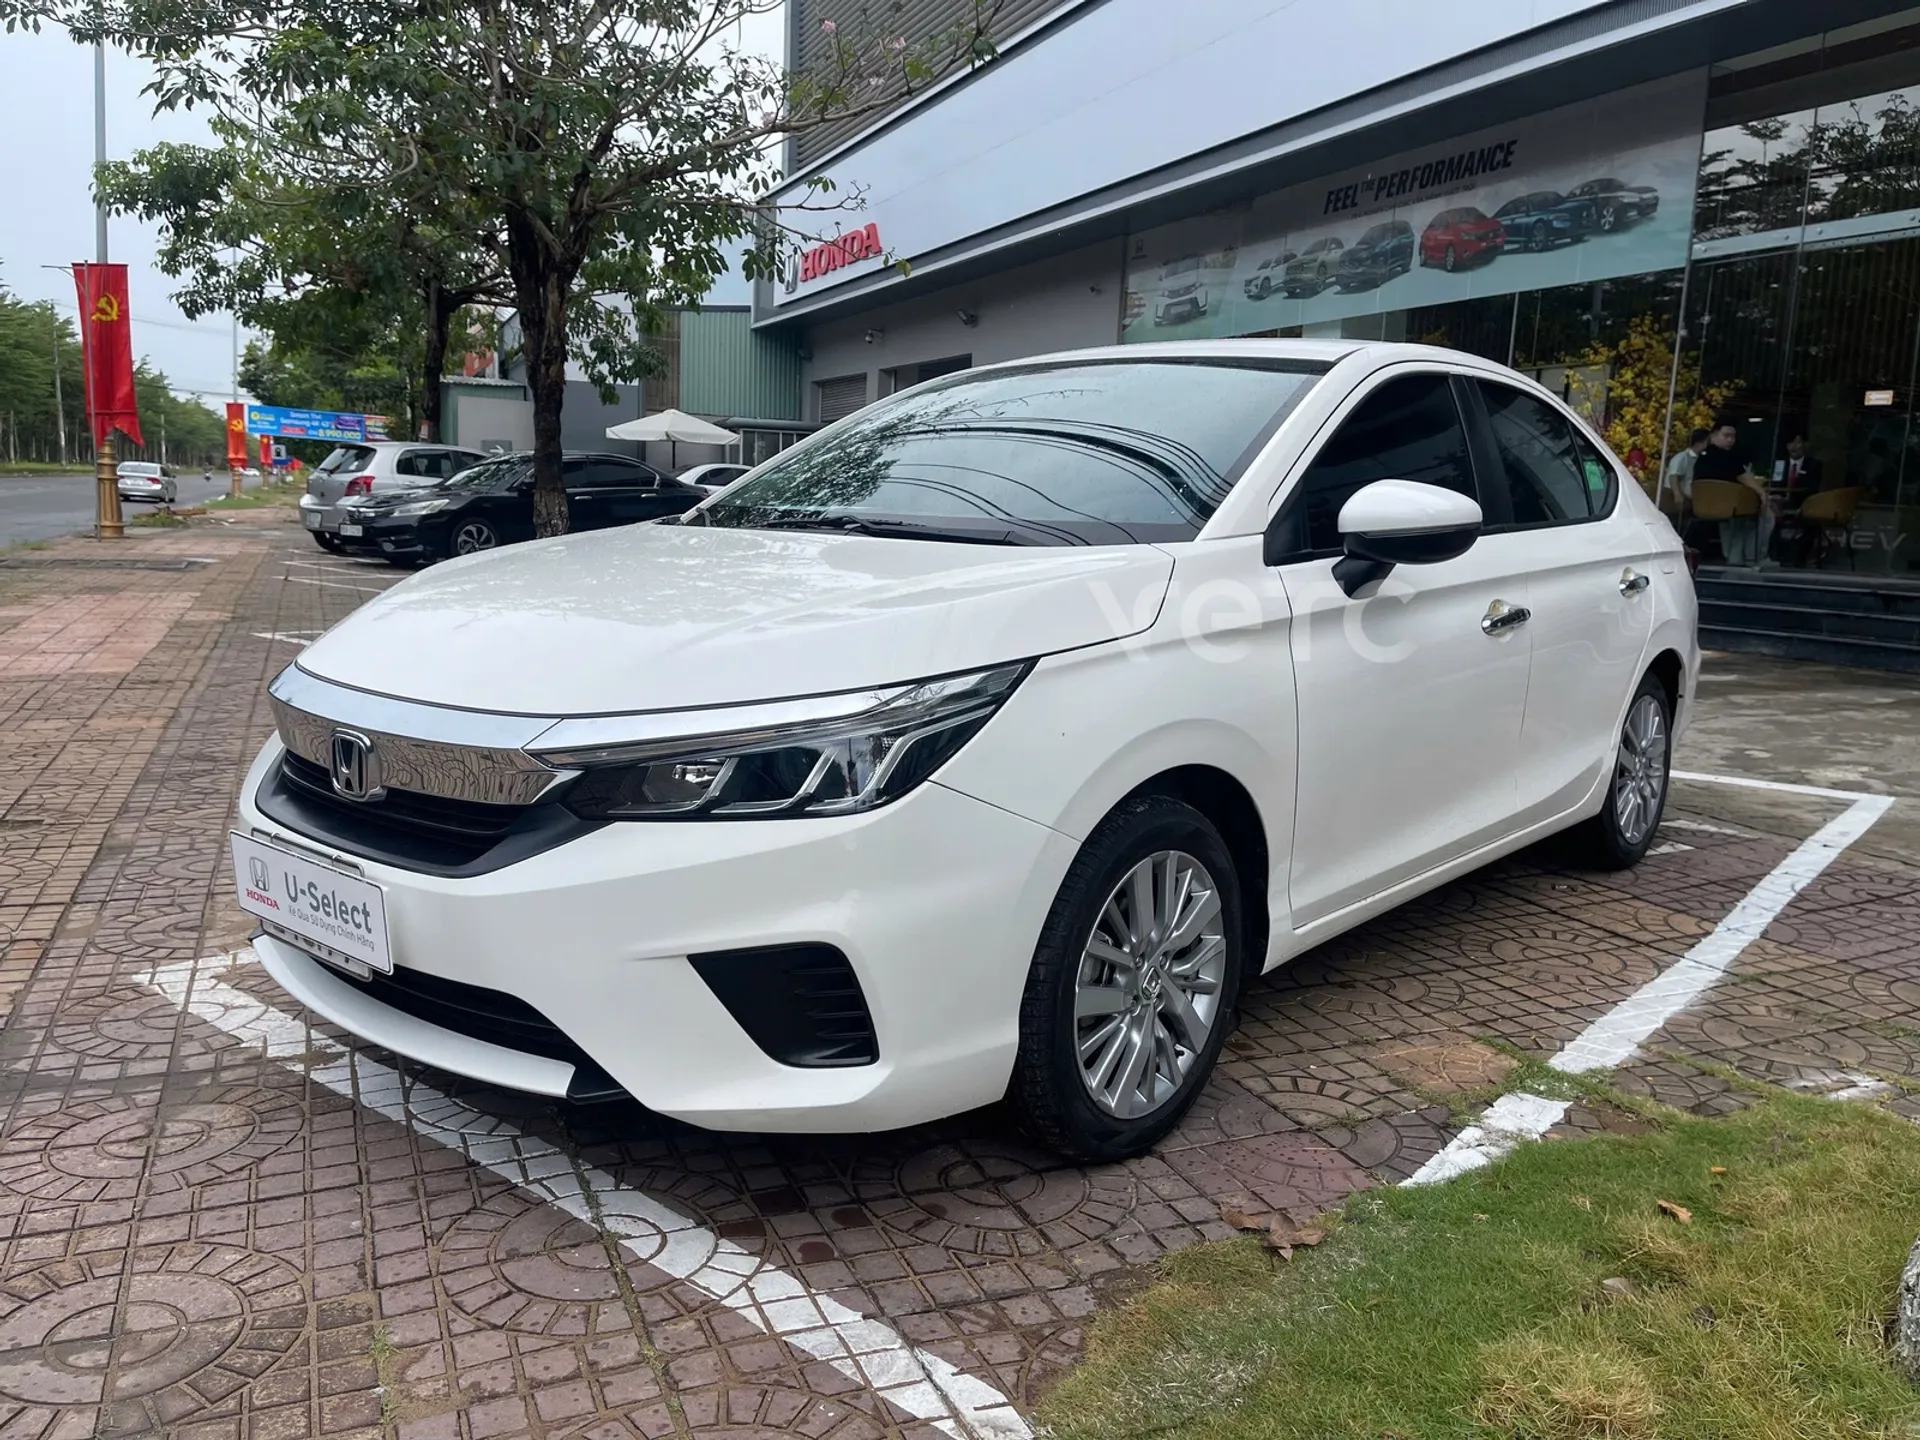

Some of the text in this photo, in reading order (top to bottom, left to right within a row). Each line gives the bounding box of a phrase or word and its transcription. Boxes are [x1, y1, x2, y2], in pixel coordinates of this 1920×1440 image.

[1323, 183, 1359, 215] FEEL
[1361, 177, 1376, 193] THE
[1374, 139, 1518, 201] PERFORMANCE
[800, 222, 882, 282] HONDA
[246, 888, 280, 910] HONDA
[284, 872, 372, 934] U-Select
[288, 905, 297, 917] Xe
[297, 908, 310, 923] Qua
[319, 917, 336, 936] Dụng
[337, 925, 356, 942] Chính
